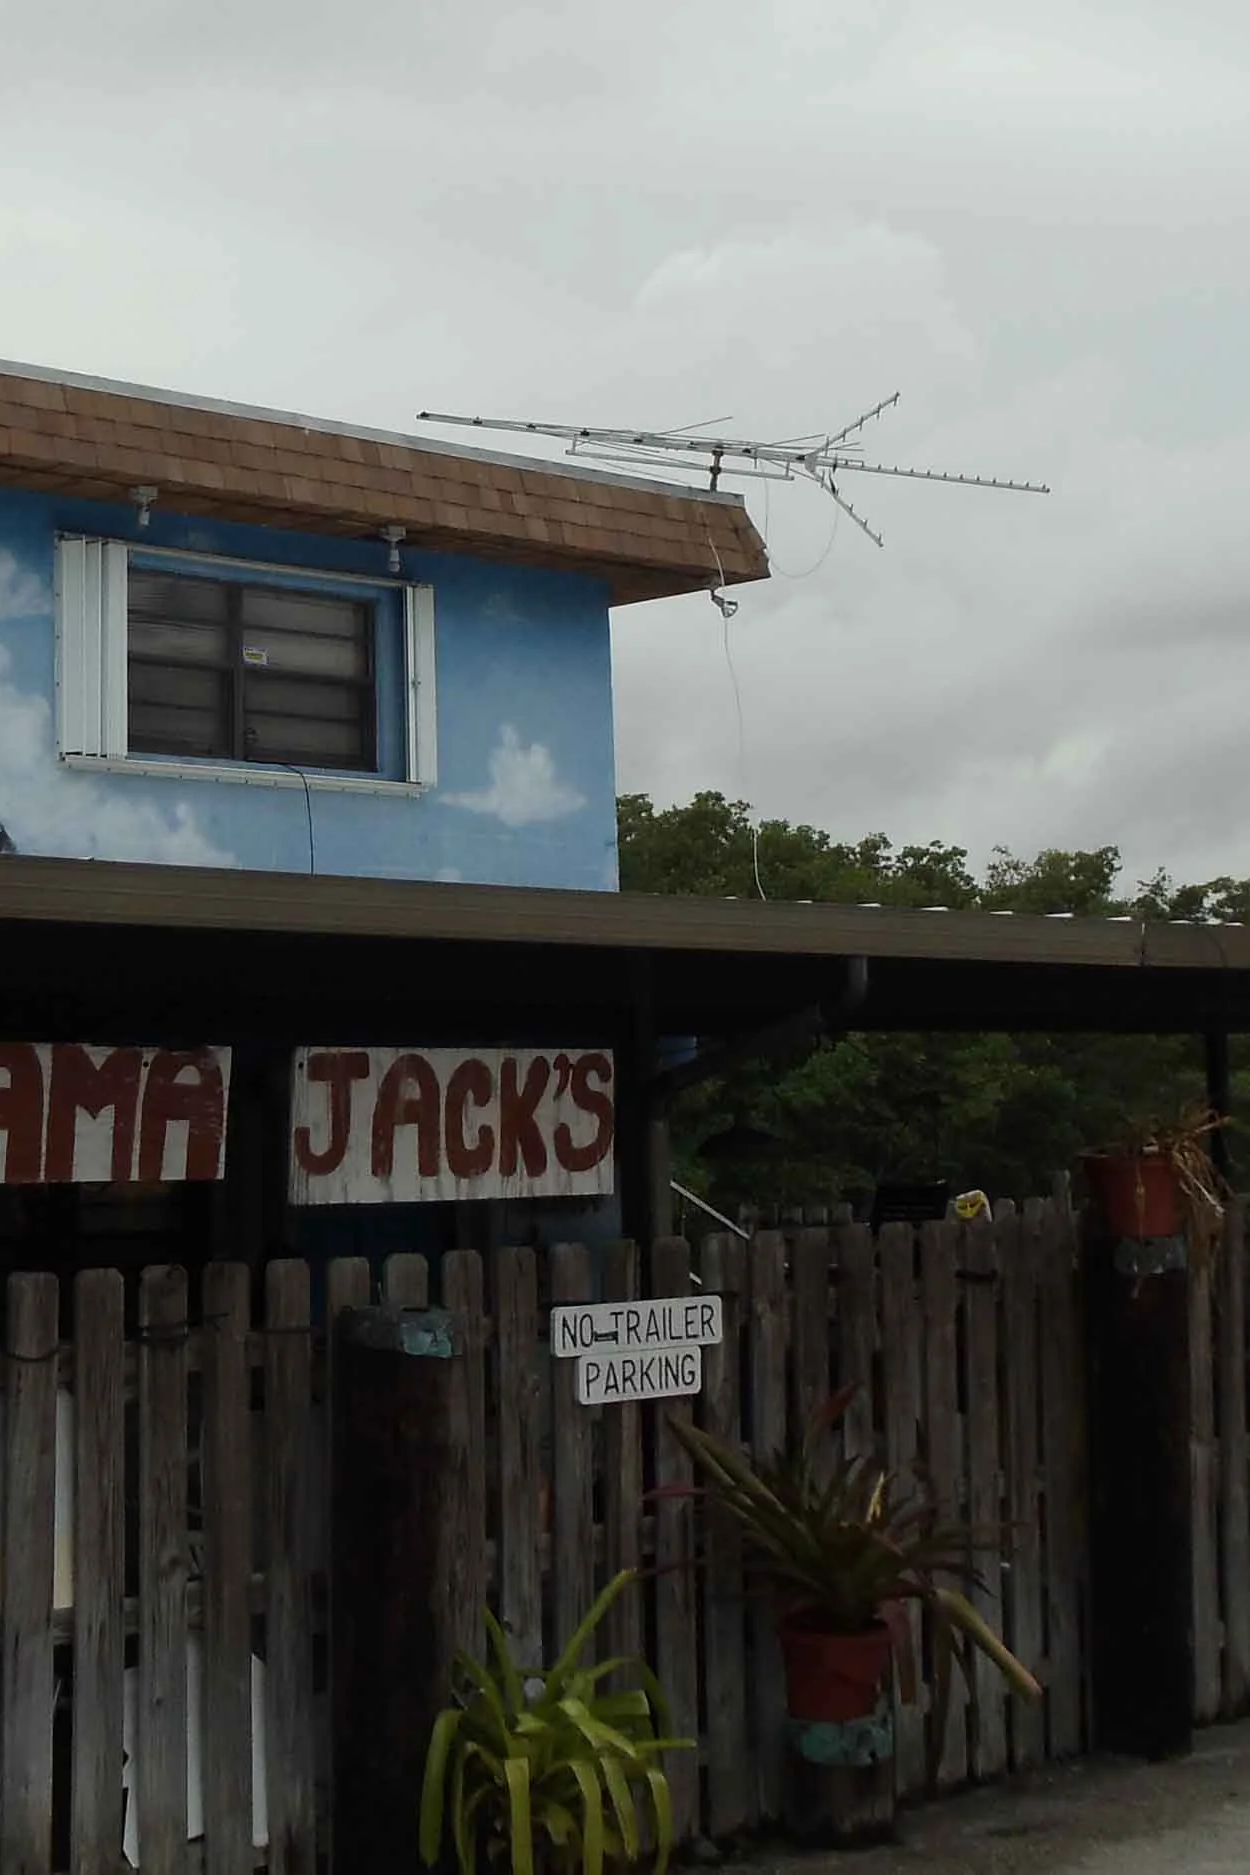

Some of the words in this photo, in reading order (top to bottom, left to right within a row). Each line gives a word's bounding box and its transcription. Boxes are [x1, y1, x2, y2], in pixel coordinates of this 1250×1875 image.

[294, 1052, 614, 1179] JACK'S
[562, 1313, 594, 1350] NO
[610, 1304, 716, 1345] TRAILER
[586, 1353, 696, 1399] PARKING
